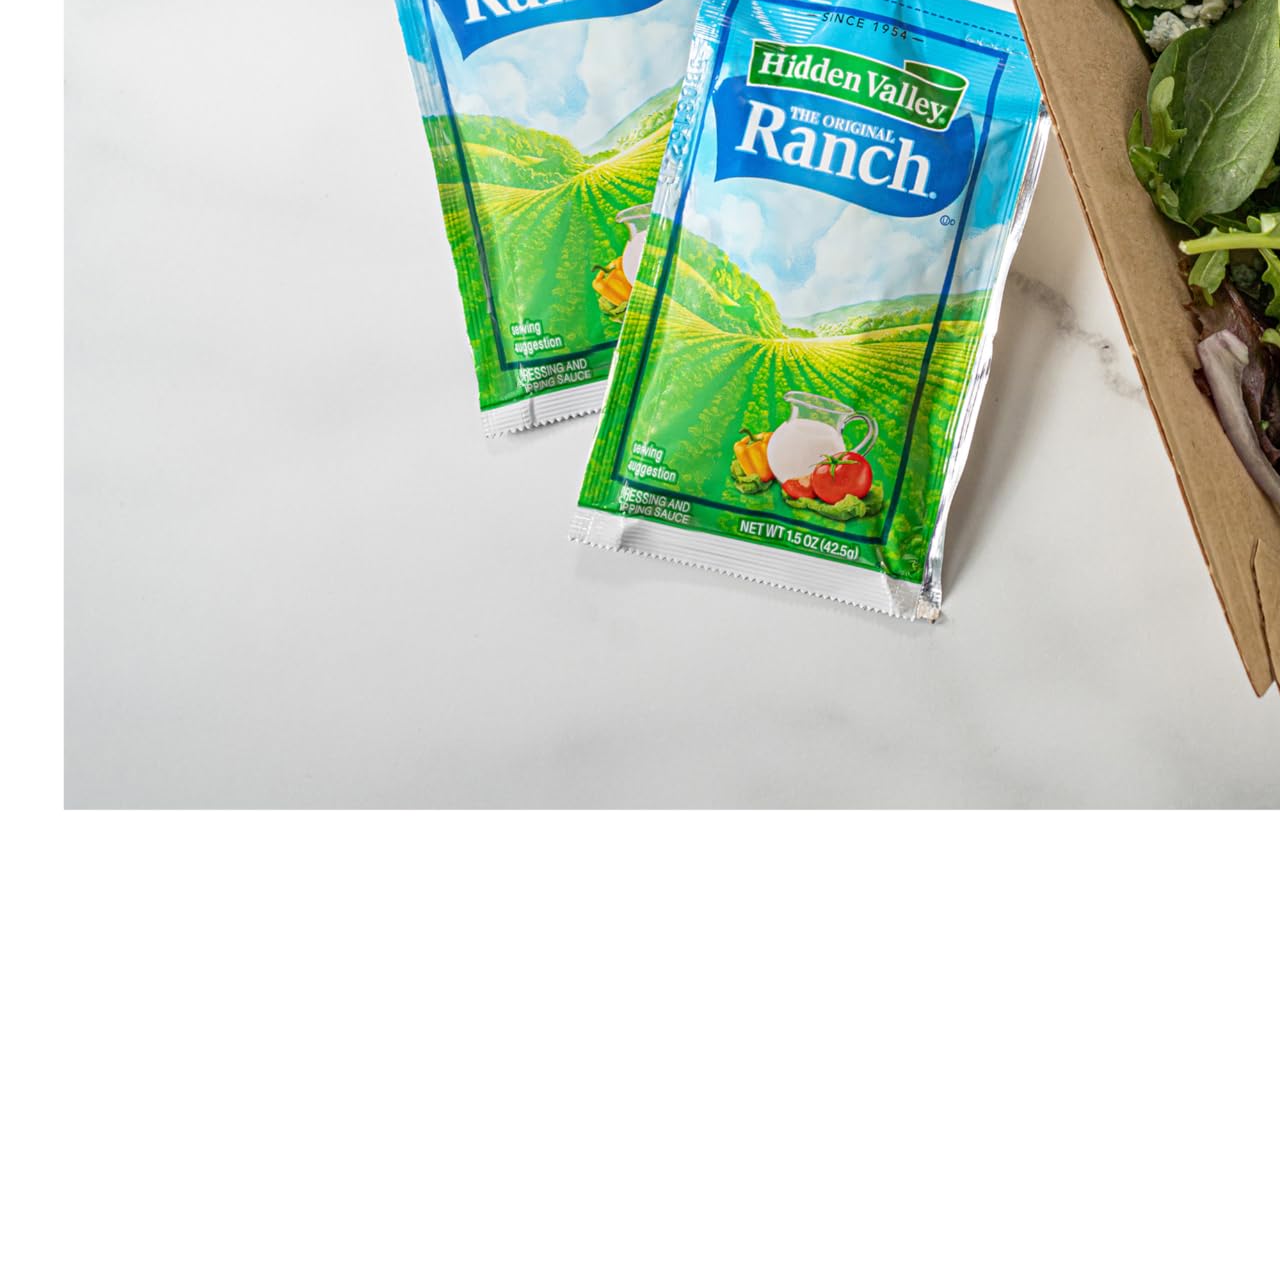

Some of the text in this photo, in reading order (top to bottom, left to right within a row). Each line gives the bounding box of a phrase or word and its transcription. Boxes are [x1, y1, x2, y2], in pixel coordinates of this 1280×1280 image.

[821, 11, 908, 42] SINCE 1954
[760, 52, 861, 93] Hidden
[790, 106, 896, 143] THE ORIGINAL
[567, 358, 588, 372] AND
[556, 369, 592, 386] SAUCE
[653, 506, 690, 524] SAUCE
[667, 498, 691, 513] AND
[739, 519, 859, 561] NET WT 1.5 OZ (42.5g)
